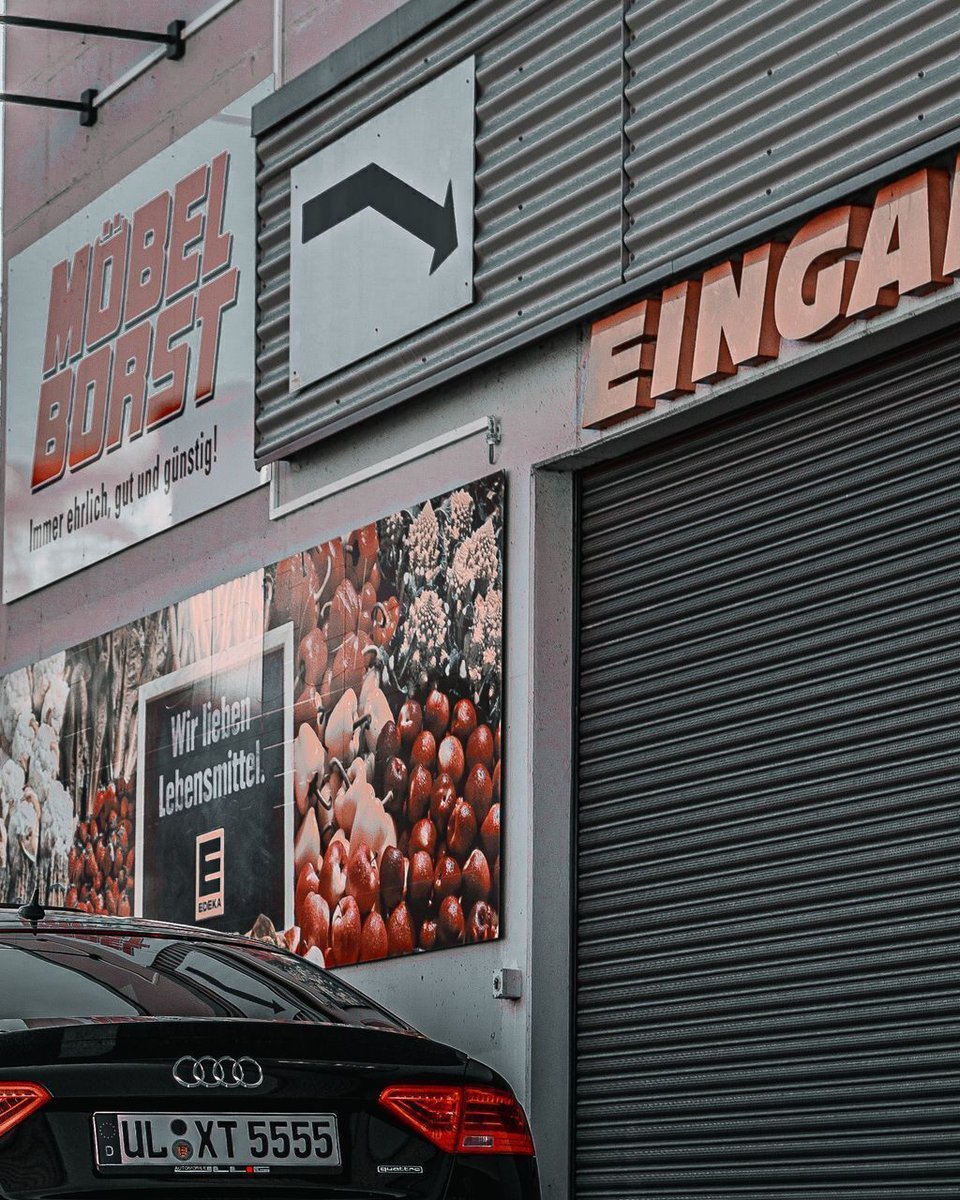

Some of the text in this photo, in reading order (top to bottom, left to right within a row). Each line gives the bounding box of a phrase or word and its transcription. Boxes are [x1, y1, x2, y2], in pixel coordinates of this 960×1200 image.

[43, 149, 233, 380] MÖBEL
[582, 151, 960, 430] EINGA
[31, 268, 240, 494] BORST
[29, 425, 218, 553] Immer ehrlich, gut und günstig!
[170, 695, 252, 758] Wir lieben
[158, 740, 266, 818] Lebensmittel.
[197, 898, 223, 913] EDEKA
[105, 1145, 114, 1157] D
[121, 1120, 333, 1158] UL XT 5555
